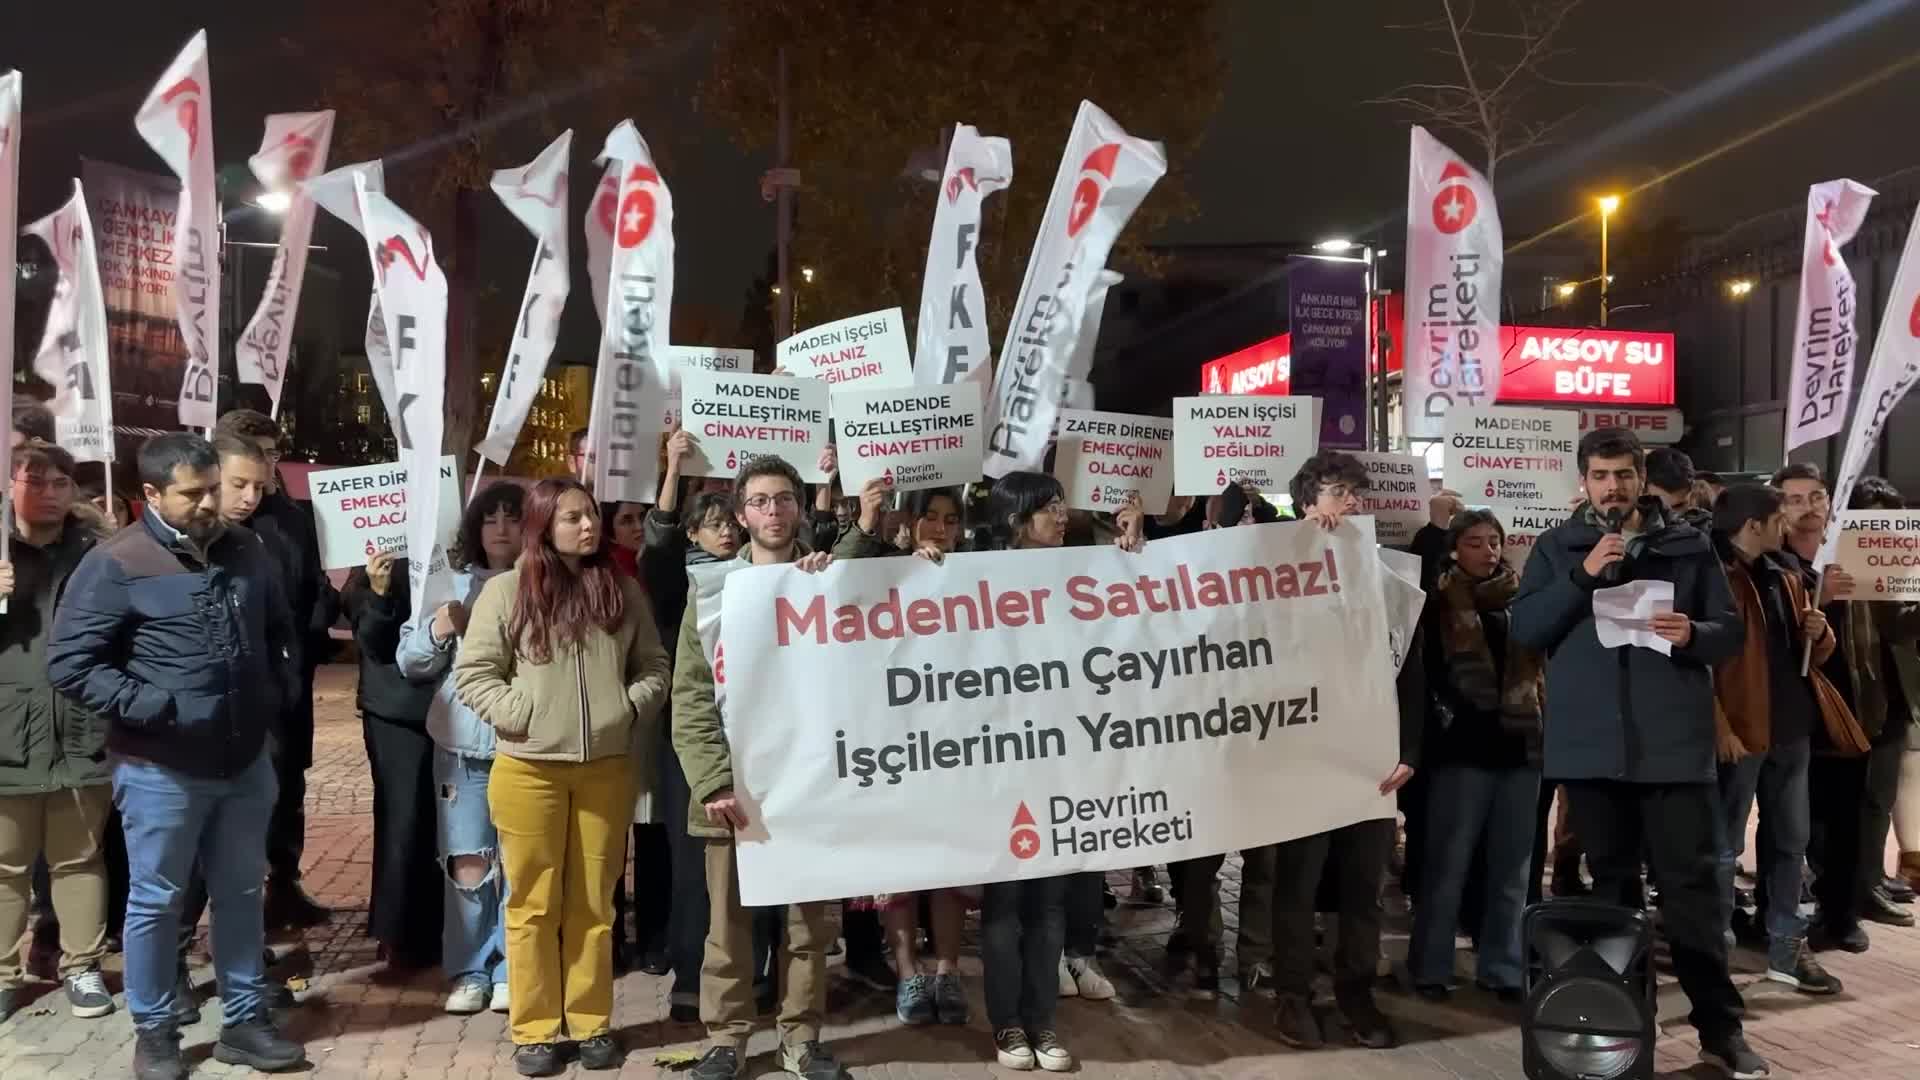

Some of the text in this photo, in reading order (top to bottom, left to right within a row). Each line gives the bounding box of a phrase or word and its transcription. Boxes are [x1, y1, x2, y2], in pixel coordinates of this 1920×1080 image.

[789, 318, 888, 355] MADEN İŞÇİSİ
[809, 346, 868, 368] YALNIZ
[1423, 284, 1454, 418] Devrim
[1521, 336, 1663, 366] AKSOY SU
[700, 354, 740, 371] İŞÇİSİ
[809, 361, 883, 385] ĞİLDİR!
[1798, 306, 1832, 428] Devrim
[1231, 360, 1276, 394] AKSOY
[1555, 366, 1632, 396] BÜFE
[715, 383, 800, 401] MADENDE
[691, 399, 822, 424] ÖZELLEŞTİRME
[866, 395, 951, 415] MADENDE
[1190, 403, 1297, 421] MADEN İŞÇİSİ
[844, 414, 974, 438] ÖZELLEŞTİRME
[1066, 419, 1117, 437] ZAFER
[1475, 417, 1552, 432] MADENDE
[1595, 411, 1668, 431] BÜFE
[703, 421, 811, 444] CİNAYETTİR!
[1213, 426, 1272, 438] YALNIZ
[1452, 432, 1573, 453] ÖZELLEŞTİRME
[857, 434, 964, 458] CİNAYETTİR!
[1082, 440, 1162, 461] EMEKÇİNİN
[1203, 442, 1285, 459] DEĞİLDİR!
[896, 463, 935, 475] Devrim
[1088, 462, 1153, 479] OLACAK!
[1229, 468, 1266, 477] Devrim
[1463, 455, 1564, 473] CİNAYETTİR!
[317, 477, 374, 494] ZAFER
[896, 472, 943, 485] Hareketi
[1497, 479, 1536, 489] Devrim
[1497, 489, 1543, 499] Hareketi
[1857, 535, 1920, 552] EMEKÇİ
[775, 549, 1342, 648] Madenler Satılamaz!
[886, 634, 1273, 707] Direnen Çayırhan
[834, 687, 1320, 788] İşçilerinin Yanındayız!
[1050, 787, 1168, 826] Devrim
[1051, 811, 1194, 858] Hareketi
